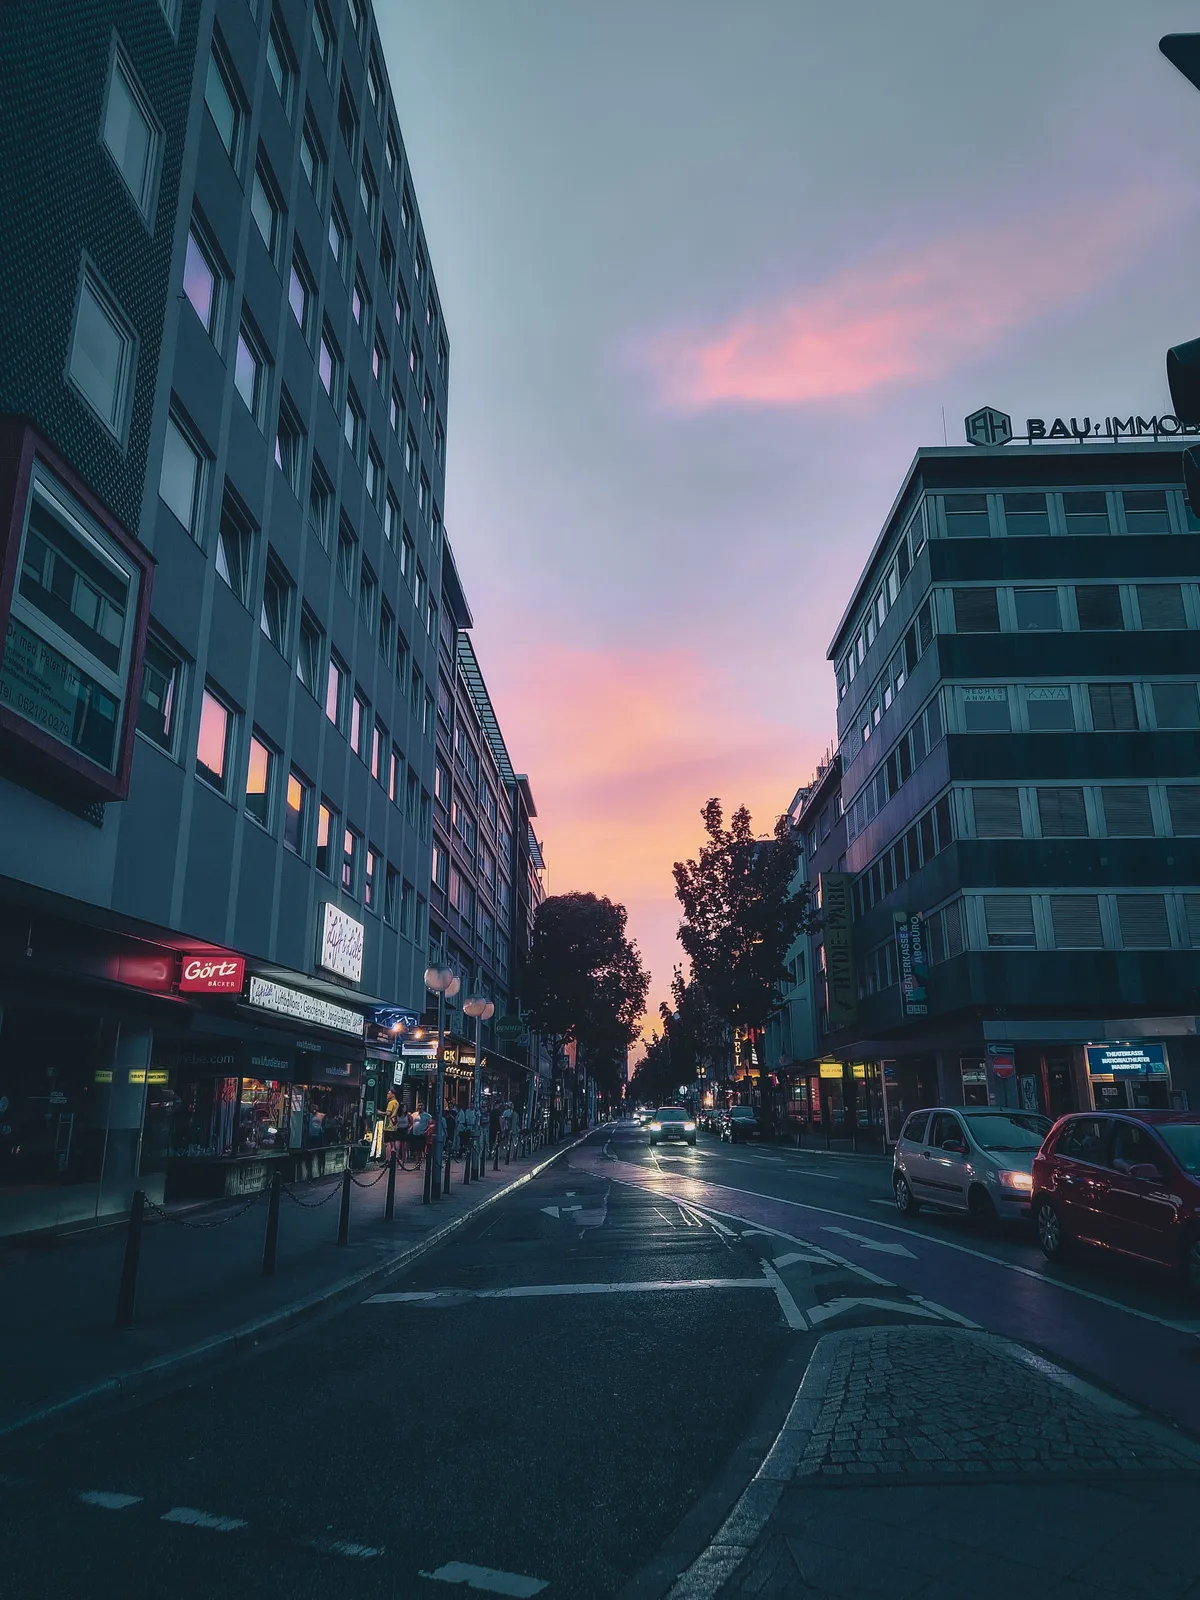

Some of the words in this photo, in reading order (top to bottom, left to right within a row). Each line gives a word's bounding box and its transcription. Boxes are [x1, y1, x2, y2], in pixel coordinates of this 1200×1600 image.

[1026, 417, 1091, 438] BAU
[965, 687, 1003, 695] RECHTS
[1028, 688, 1066, 699] KAYA
[900, 924, 909, 932] &
[910, 916, 923, 964] ABOBÜRO
[184, 960, 238, 980] Görtz
[899, 933, 914, 1003] THEATERKASSE
[207, 980, 235, 988] BÄCKER
